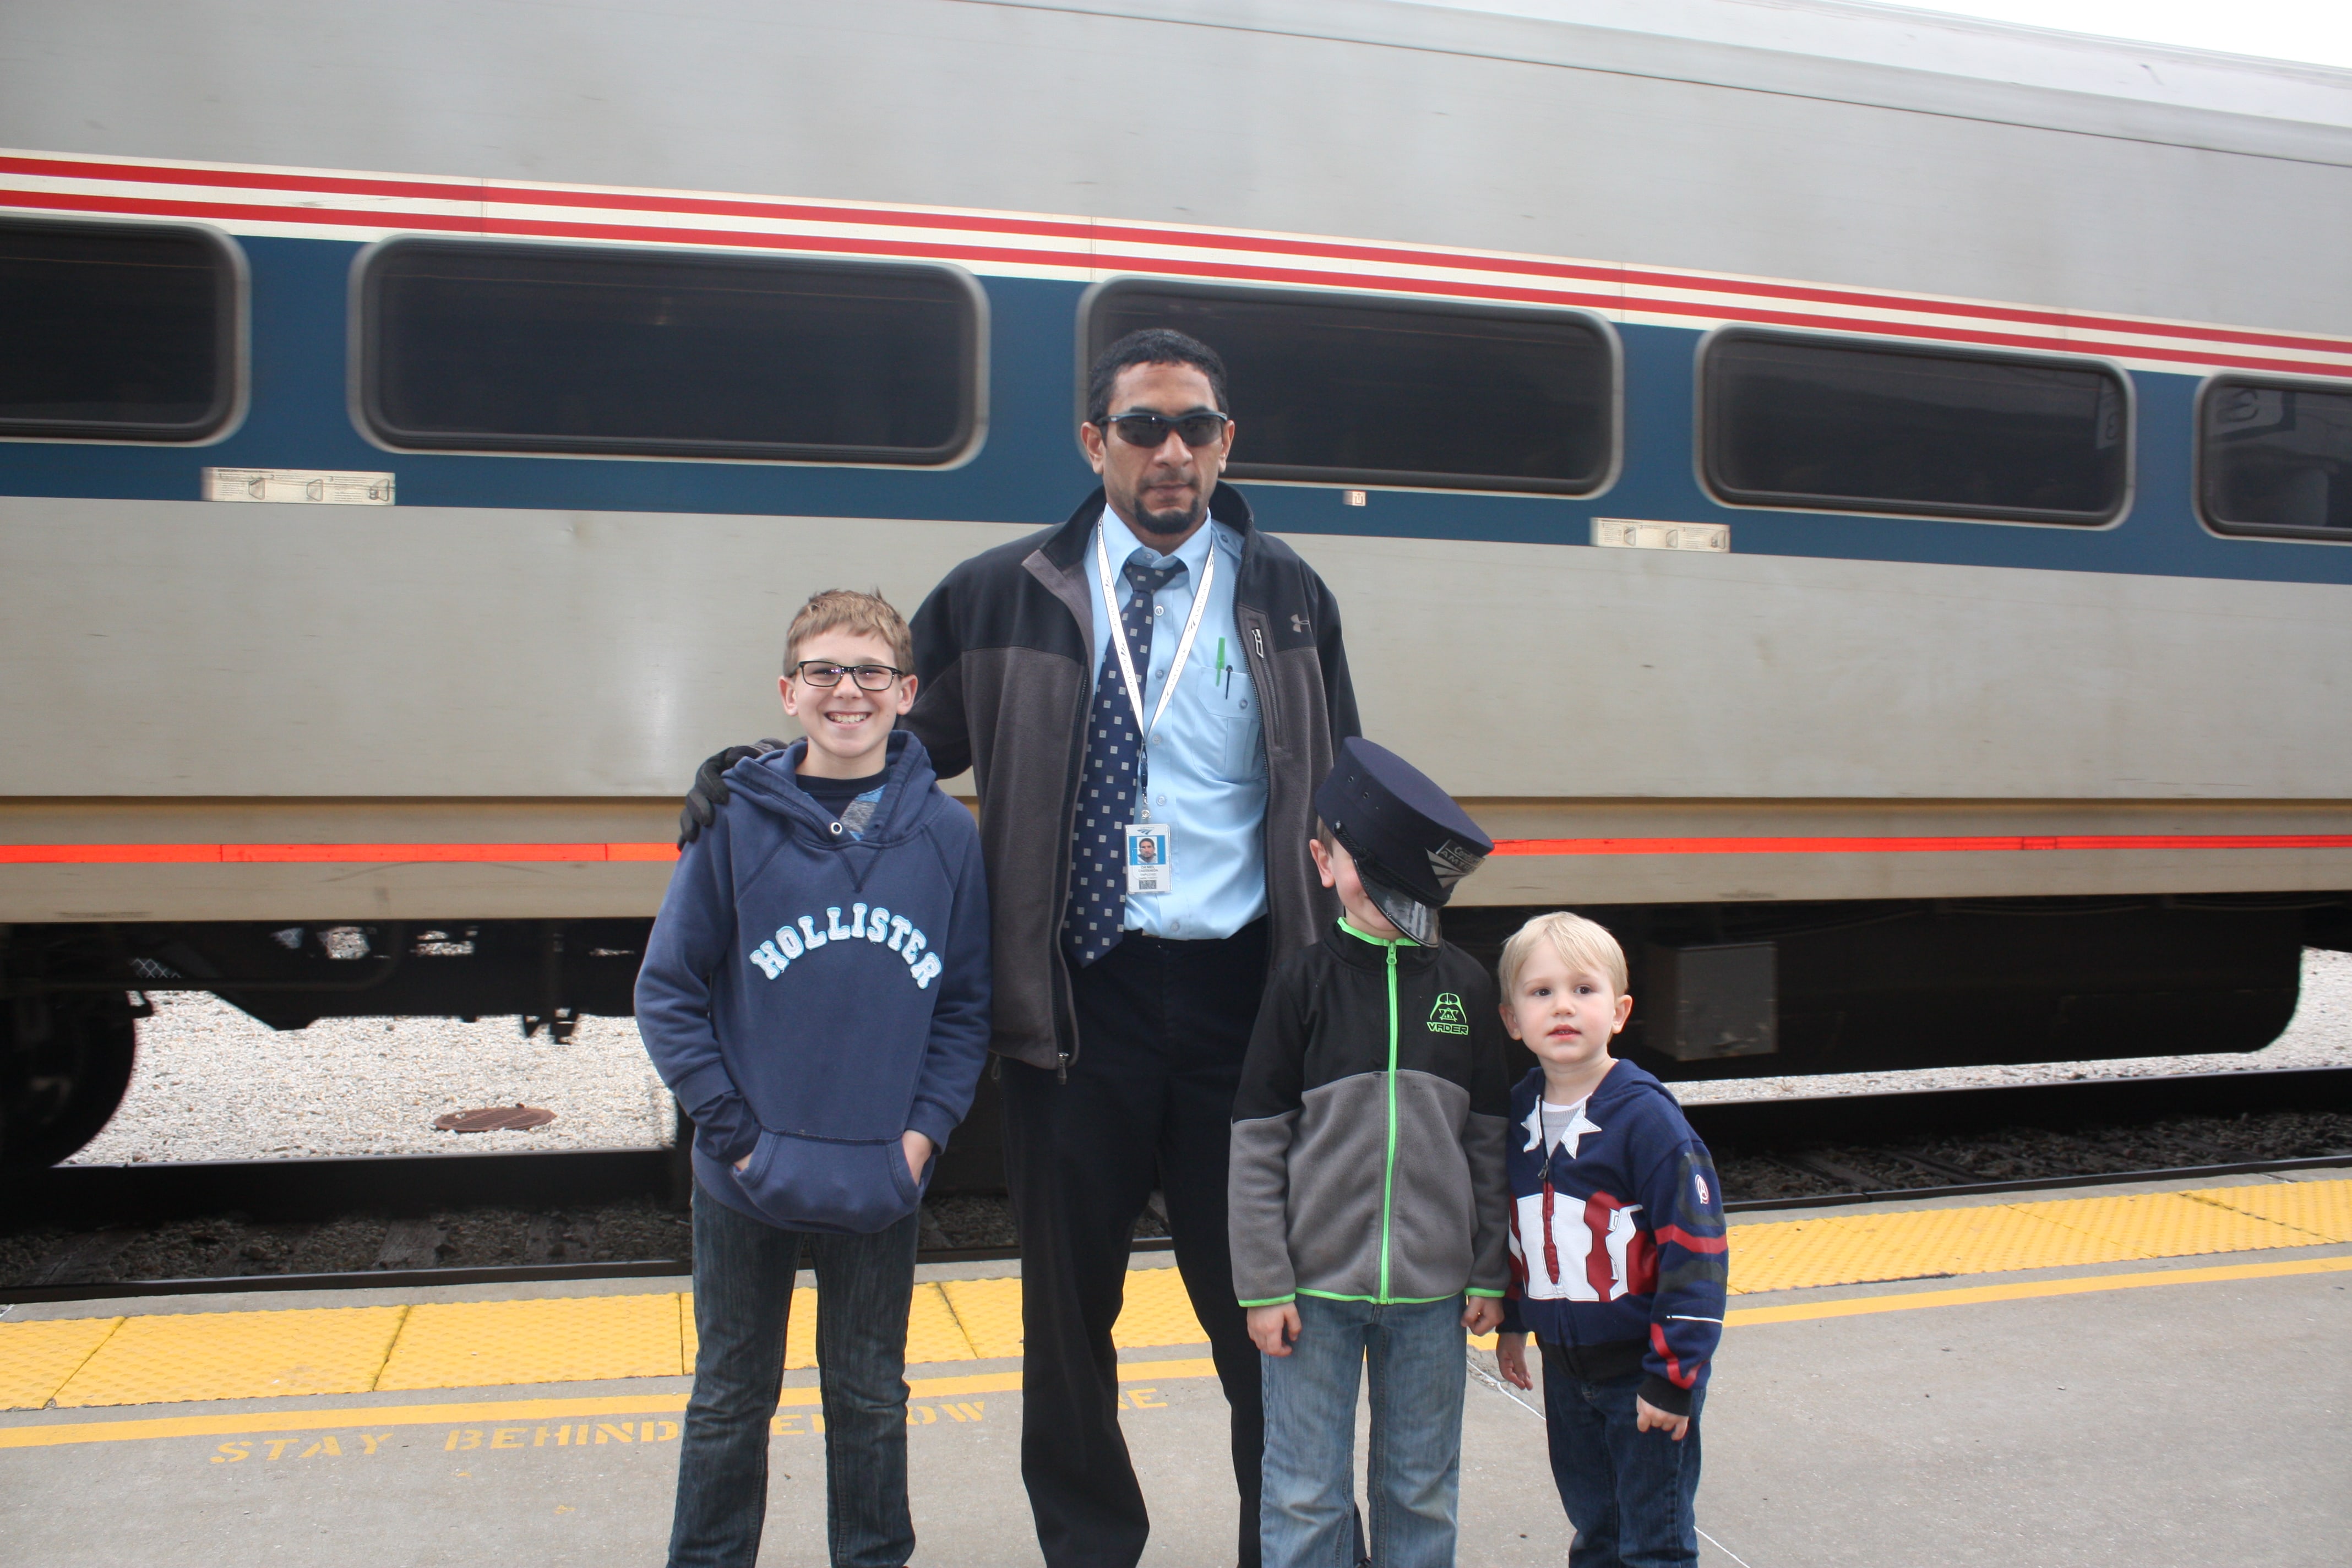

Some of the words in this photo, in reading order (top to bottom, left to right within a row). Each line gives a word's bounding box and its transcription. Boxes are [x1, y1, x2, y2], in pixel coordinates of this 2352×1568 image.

[749, 902, 943, 989] HOLLISTER
[1427, 1022, 1469, 1035] VADER
[210, 1433, 393, 1463] STAY
[444, 1420, 679, 1451] BEHIND
